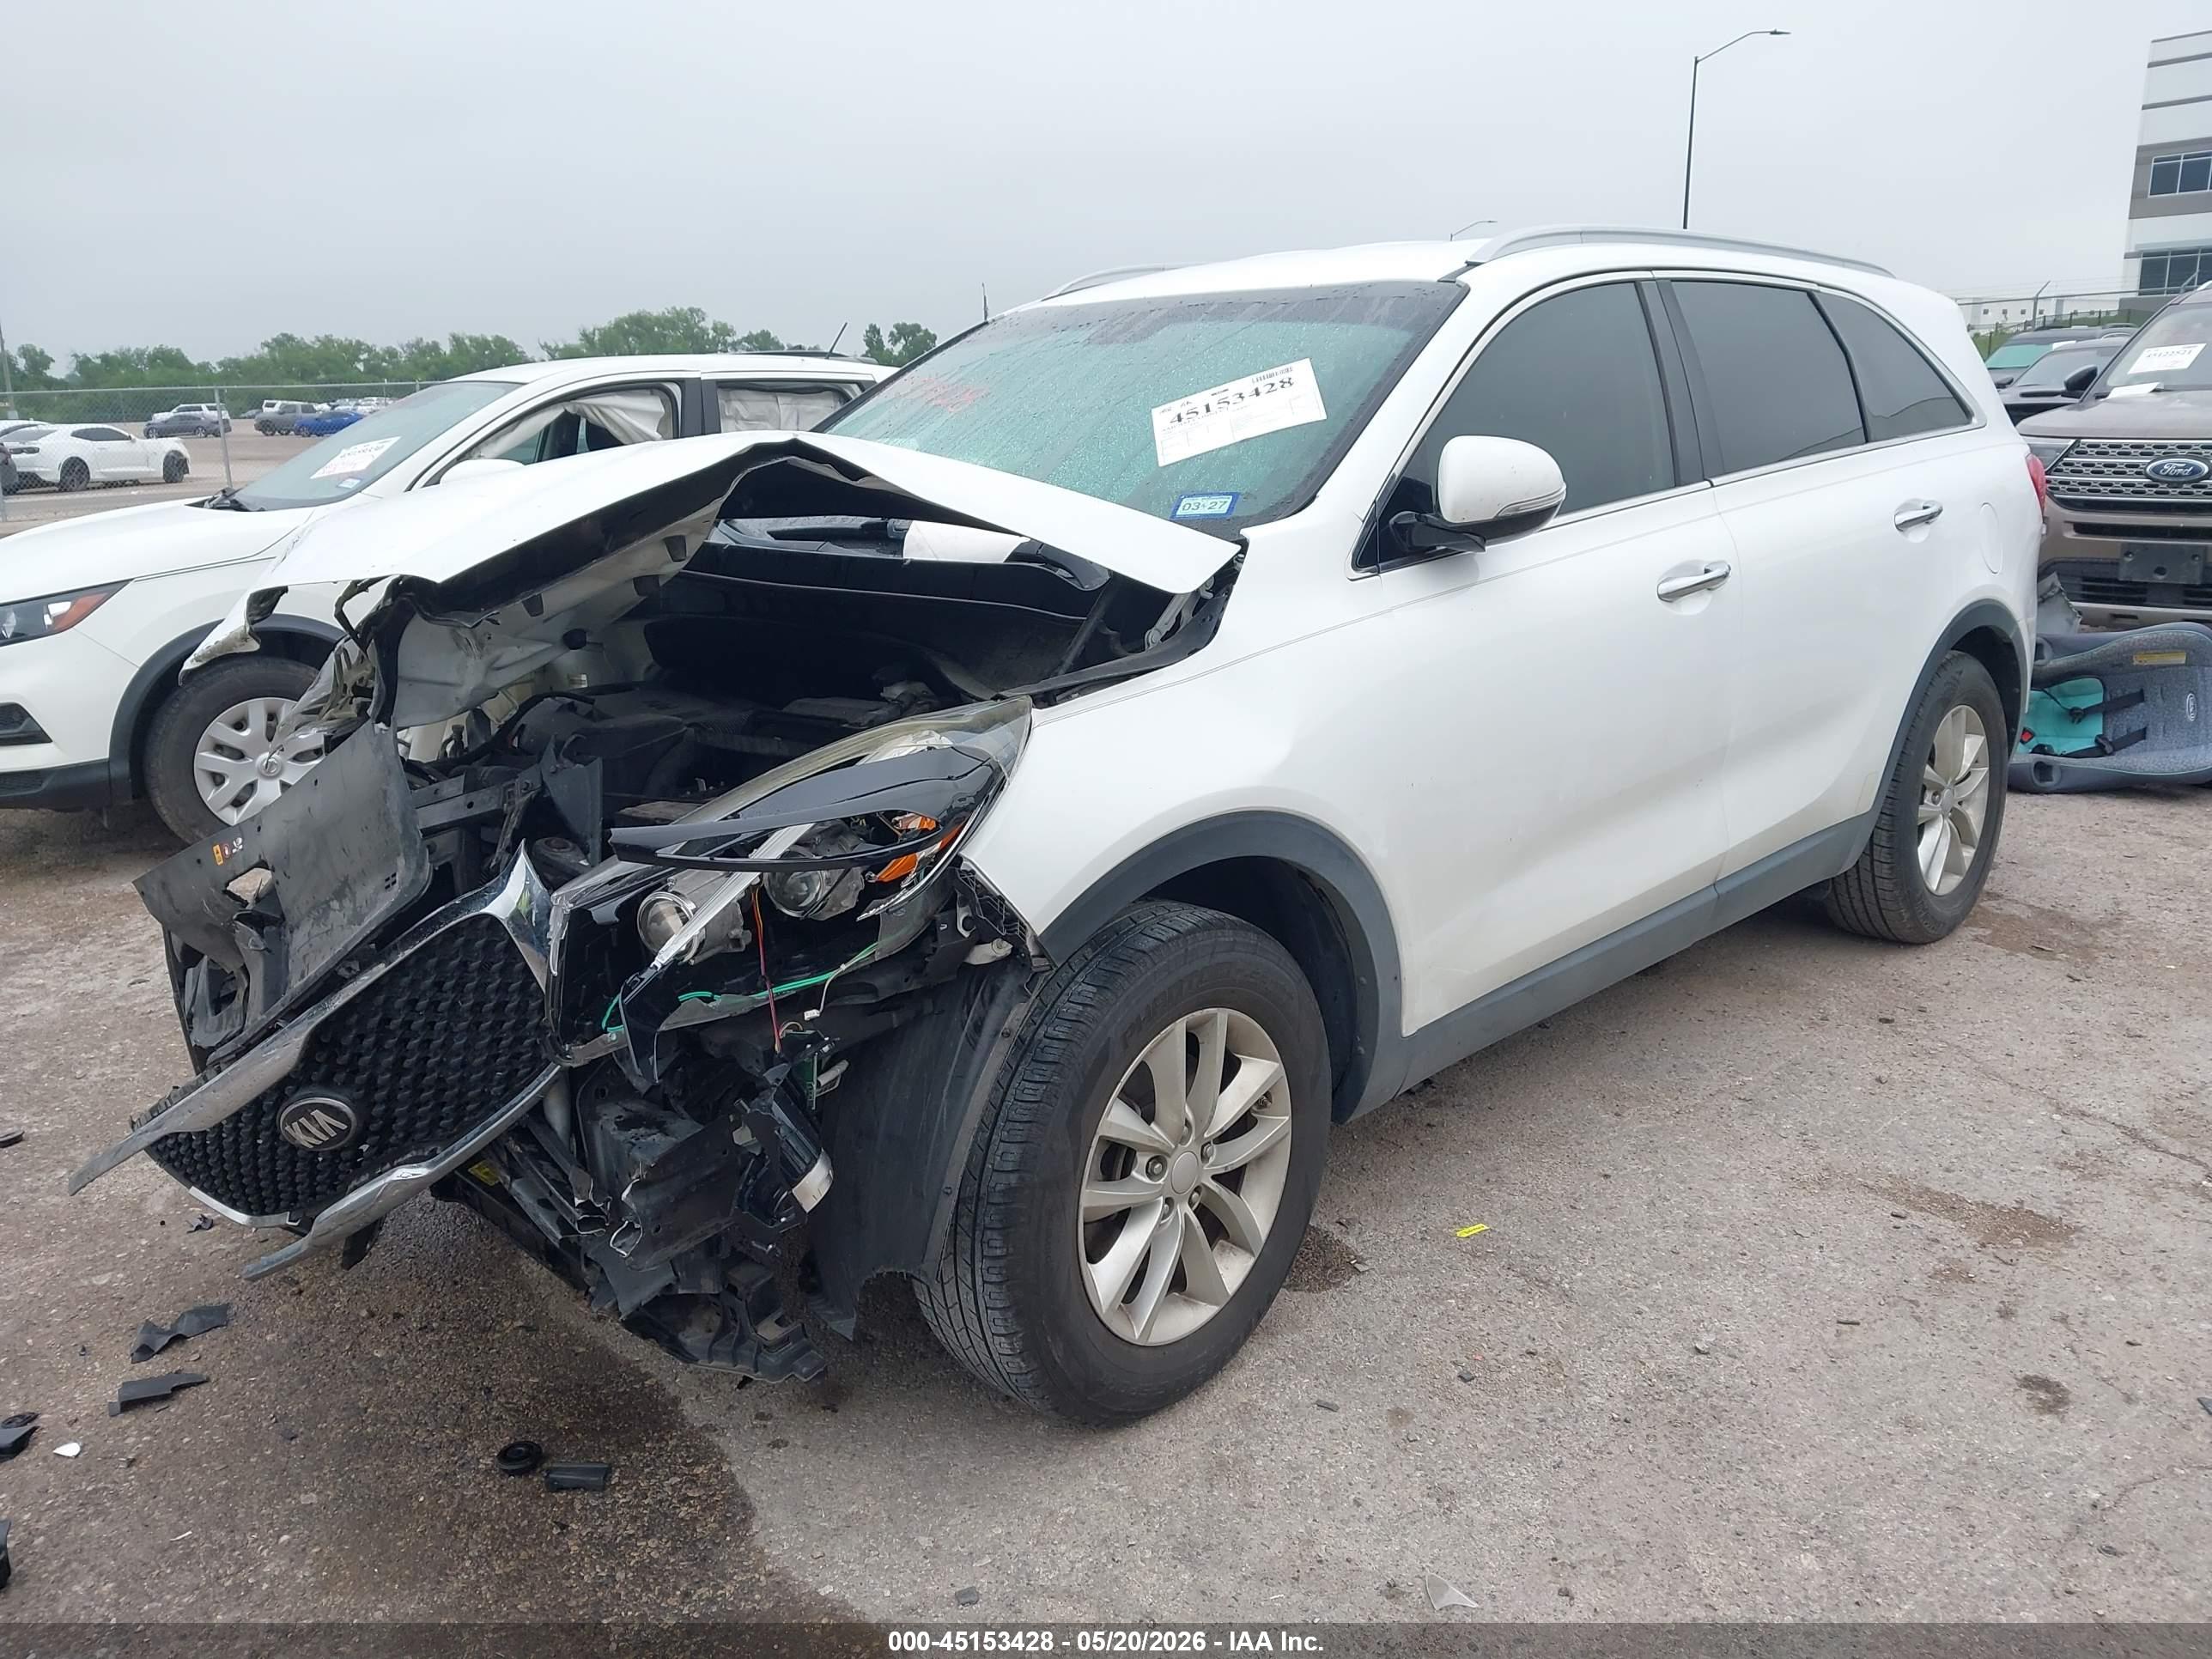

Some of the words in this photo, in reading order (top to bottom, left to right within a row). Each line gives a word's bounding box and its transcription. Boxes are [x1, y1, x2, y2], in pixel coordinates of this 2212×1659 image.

[1169, 376, 1295, 423] 45153428
[2159, 462, 2194, 476] Ford
[1182, 501, 1201, 511] 03
[1206, 501, 1228, 510] 27
[284, 1109, 349, 1149] KIA
